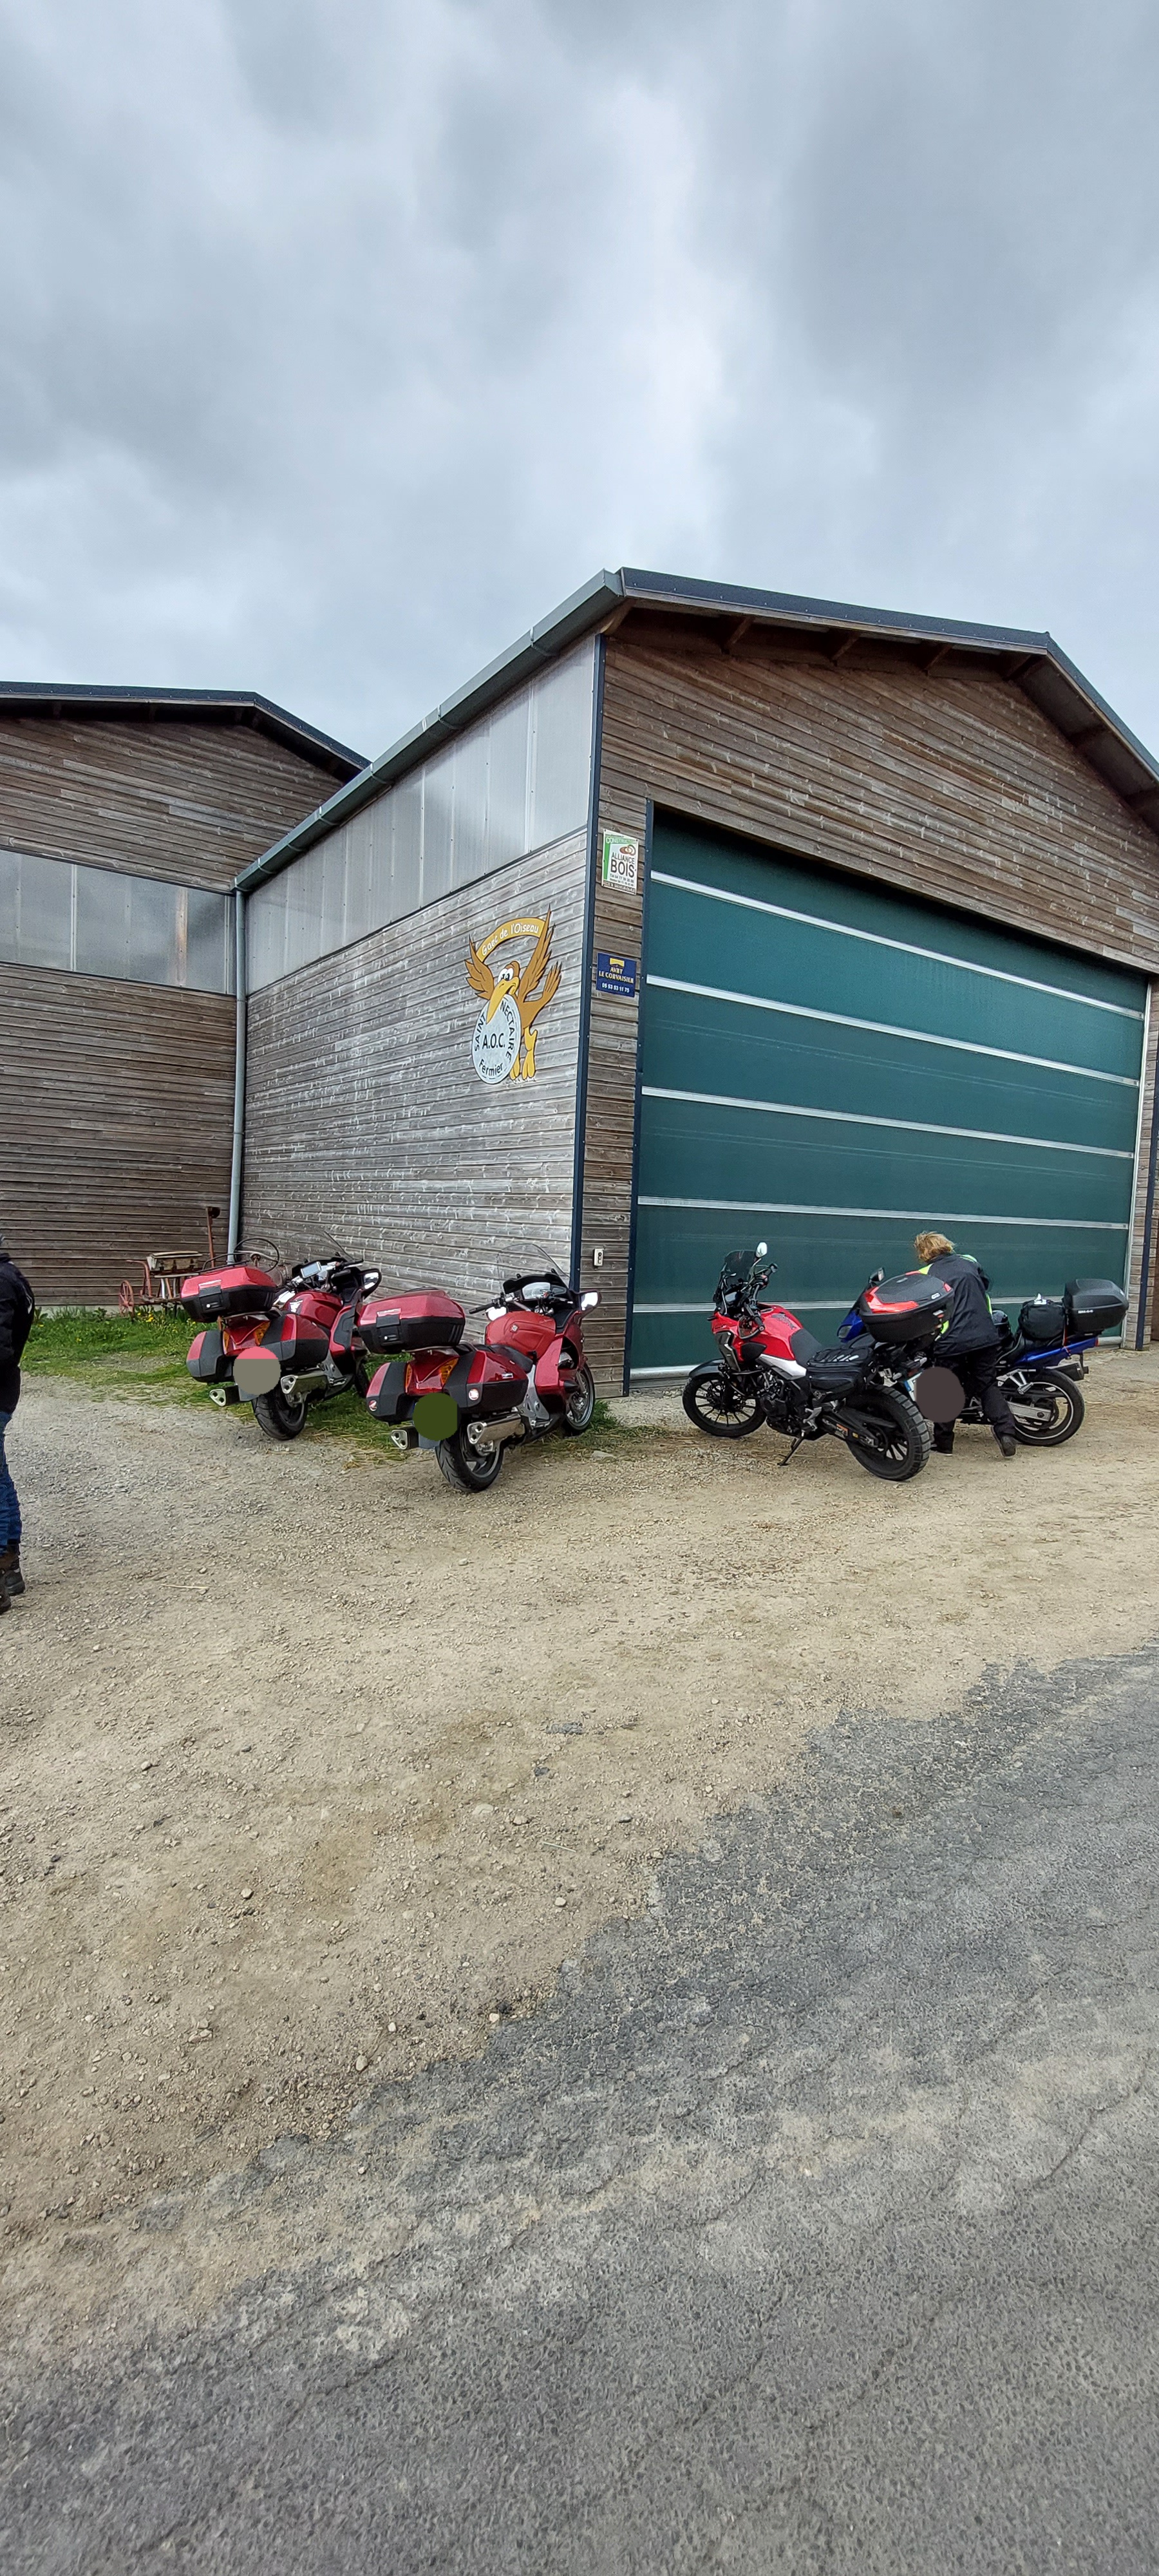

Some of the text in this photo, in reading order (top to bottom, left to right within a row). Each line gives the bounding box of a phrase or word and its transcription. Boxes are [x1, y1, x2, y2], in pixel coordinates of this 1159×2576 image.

[612, 852, 635, 864] ALLIANCE
[610, 859, 634, 878] BOIS
[482, 923, 539, 956] Gaec de l'Oiseau
[475, 1000, 515, 1063] SAINT NECTAIRE
[482, 1032, 505, 1050] A.O.C.
[478, 1059, 504, 1076] Fermier
